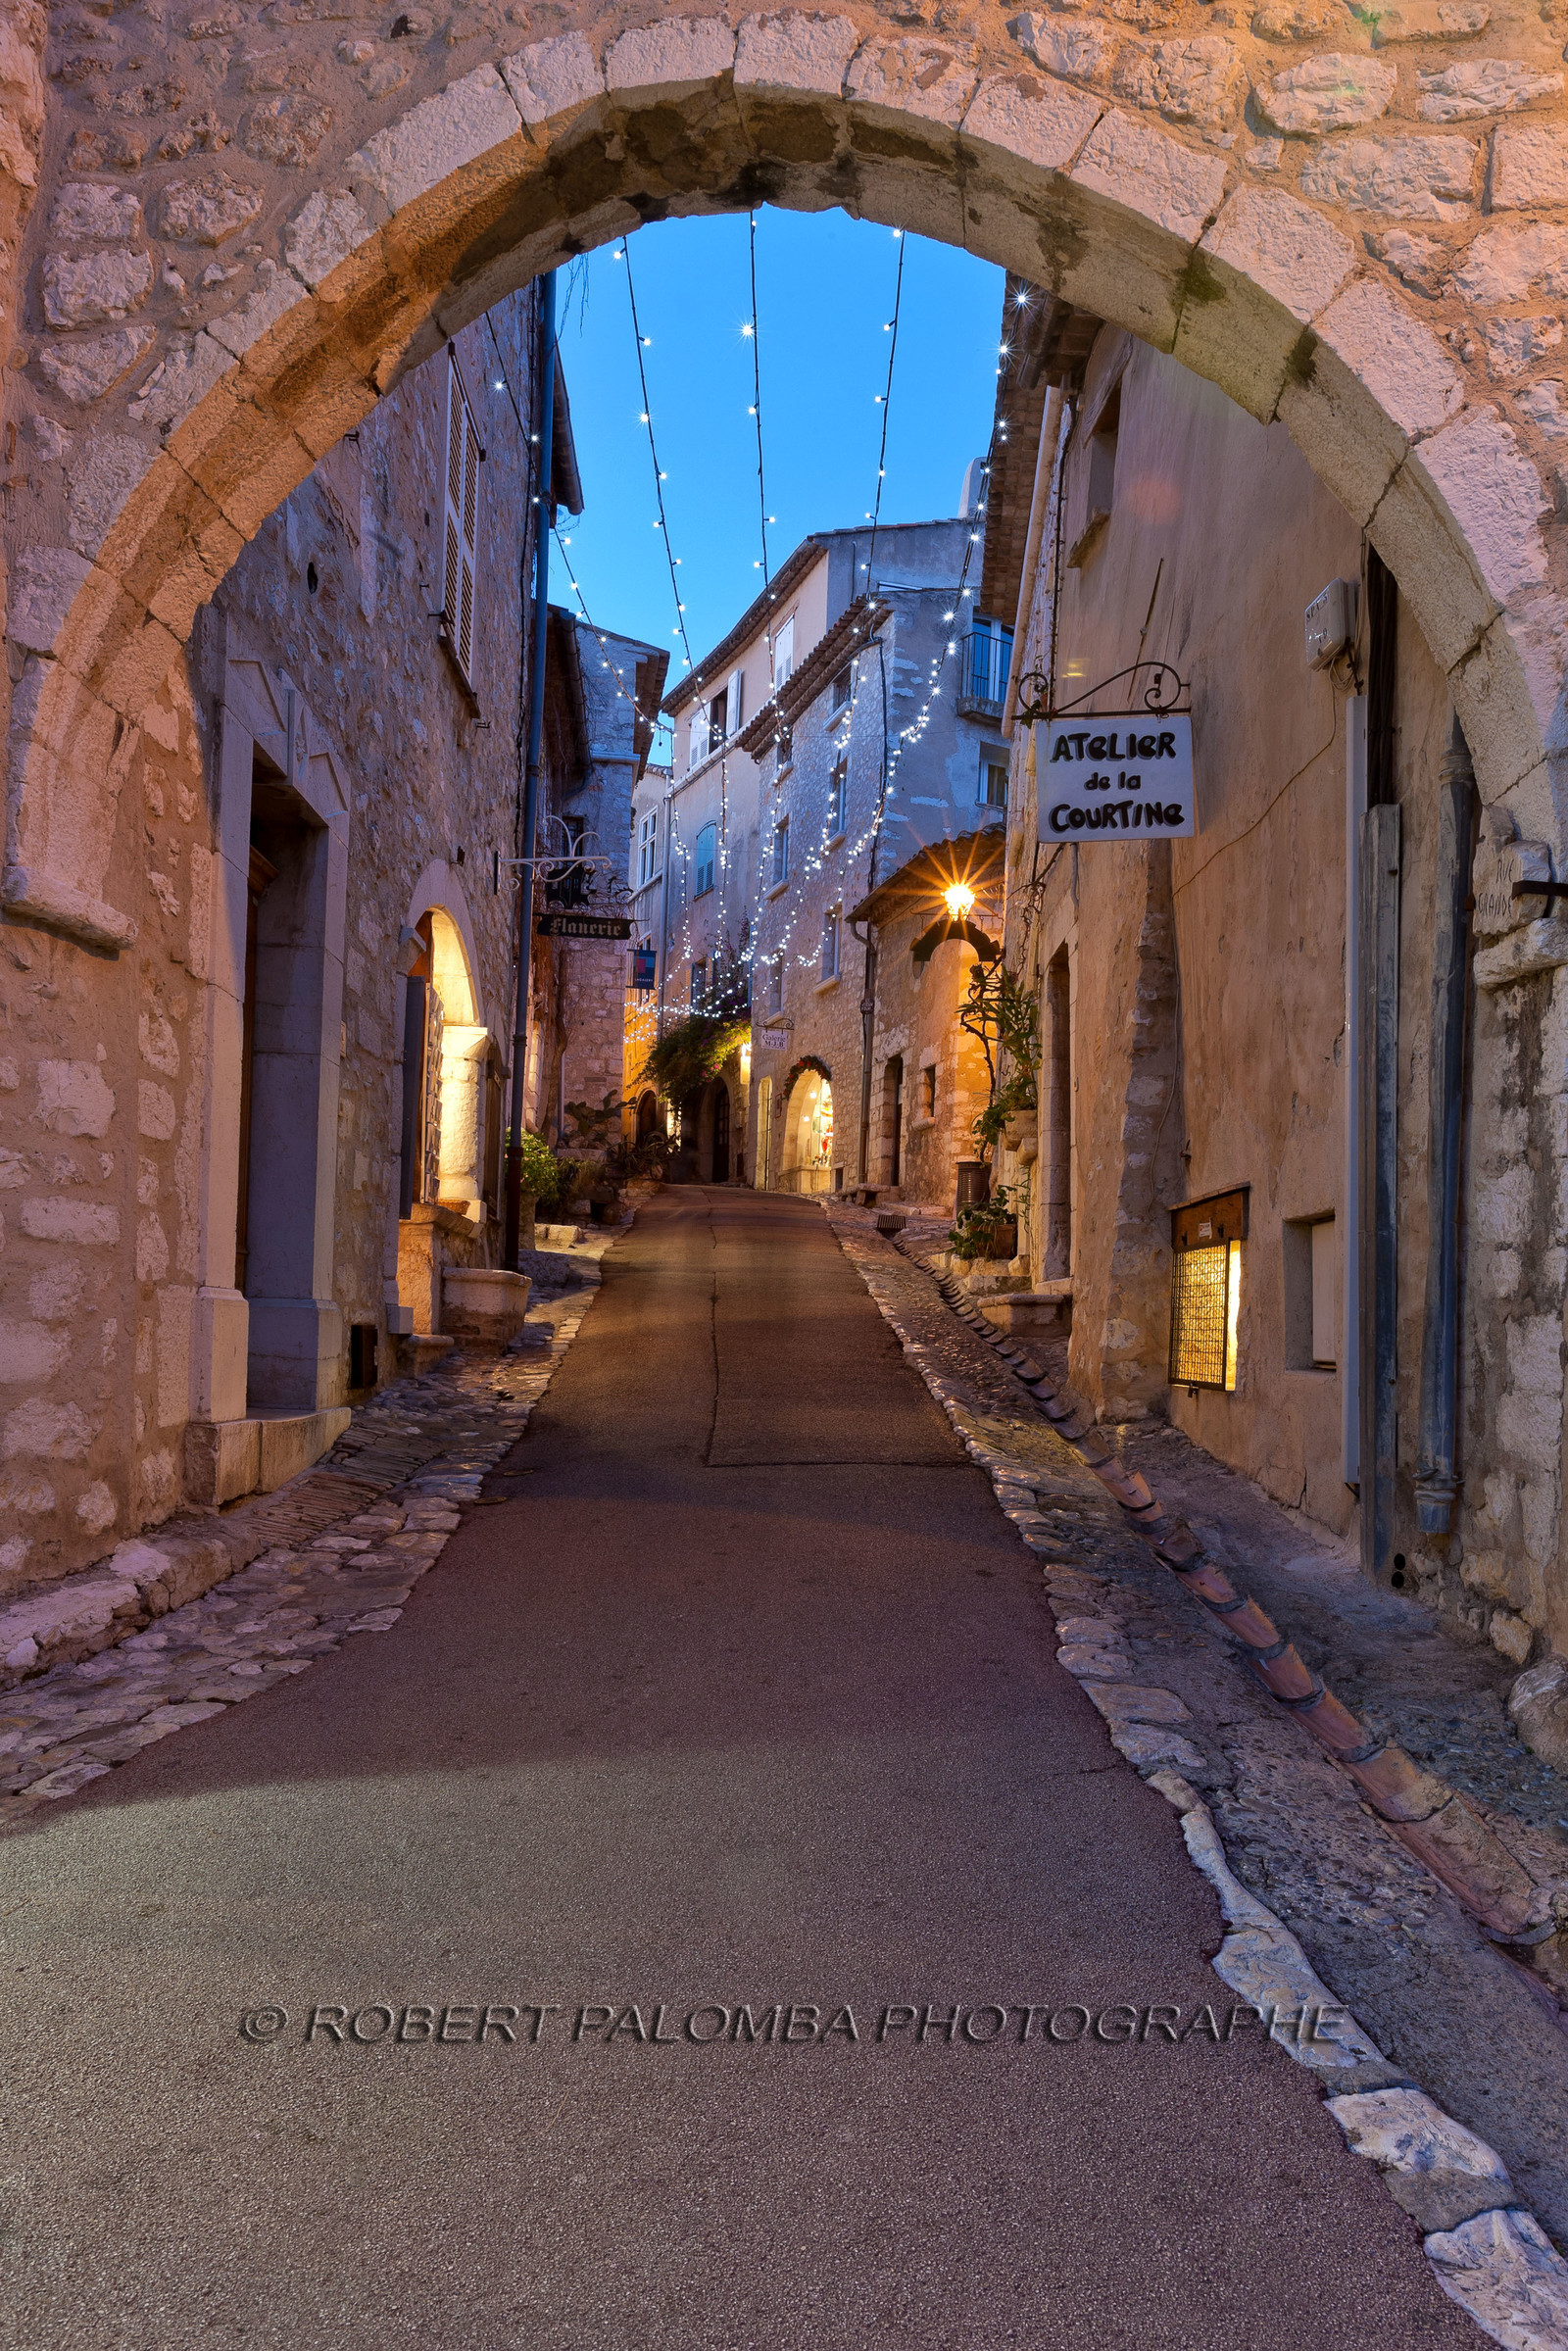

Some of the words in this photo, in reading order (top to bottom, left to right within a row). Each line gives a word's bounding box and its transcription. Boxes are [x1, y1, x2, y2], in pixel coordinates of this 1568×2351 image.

[1084, 771, 1111, 791] de
[1117, 770, 1142, 790] la
[1478, 892, 1512, 919] GRANDE
[550, 917, 621, 937] Flanerie
